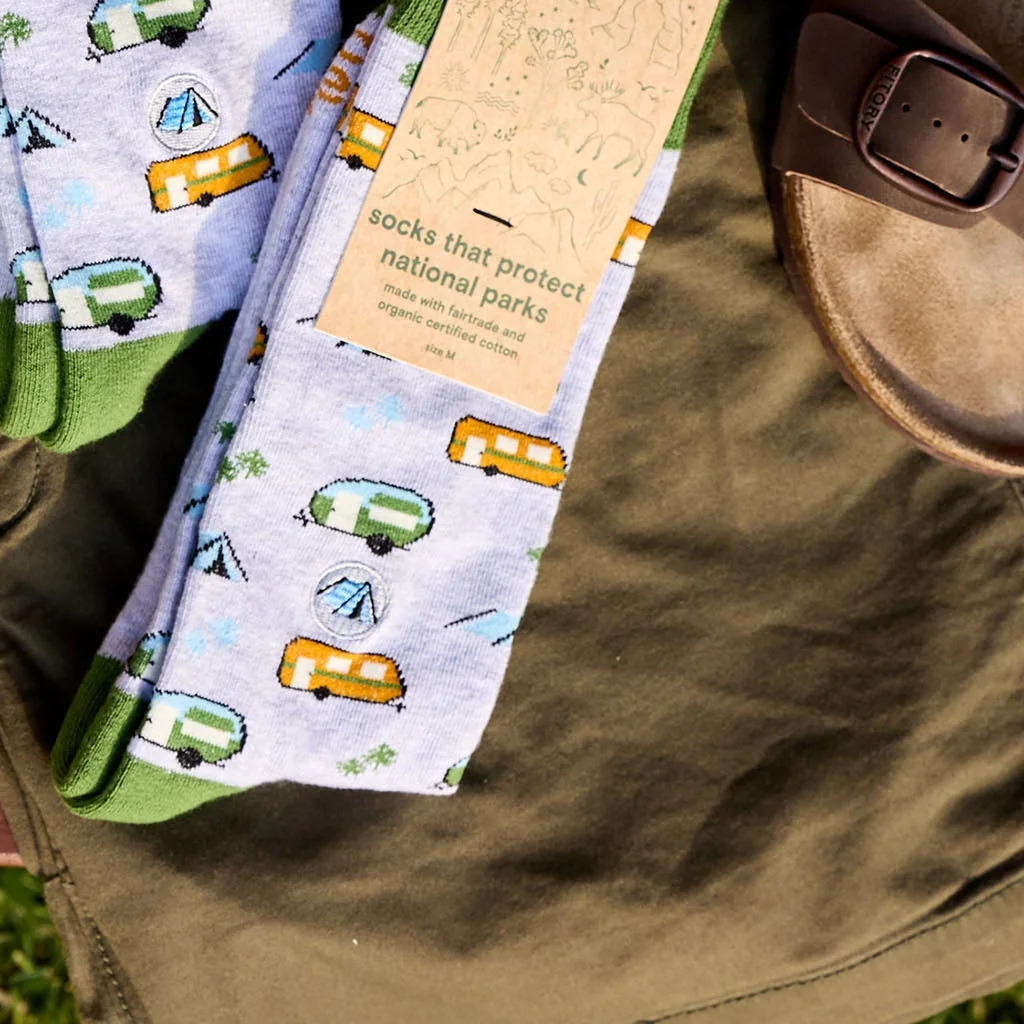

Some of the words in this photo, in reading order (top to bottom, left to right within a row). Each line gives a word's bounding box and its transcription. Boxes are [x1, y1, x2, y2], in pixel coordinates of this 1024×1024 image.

[368, 208, 437, 246] socks
[443, 232, 493, 267] that
[495, 256, 586, 303] protect
[379, 248, 479, 297] national
[480, 286, 548, 324] parks
[377, 300, 423, 325] organic
[425, 318, 477, 344] certified
[479, 336, 519, 361] cotton
[383, 282, 417, 302] made
[420, 296, 445, 313] with
[448, 304, 500, 333] fairtrade
[502, 327, 526, 343] and
[424, 343, 444, 357] size
[445, 349, 457, 361] M
